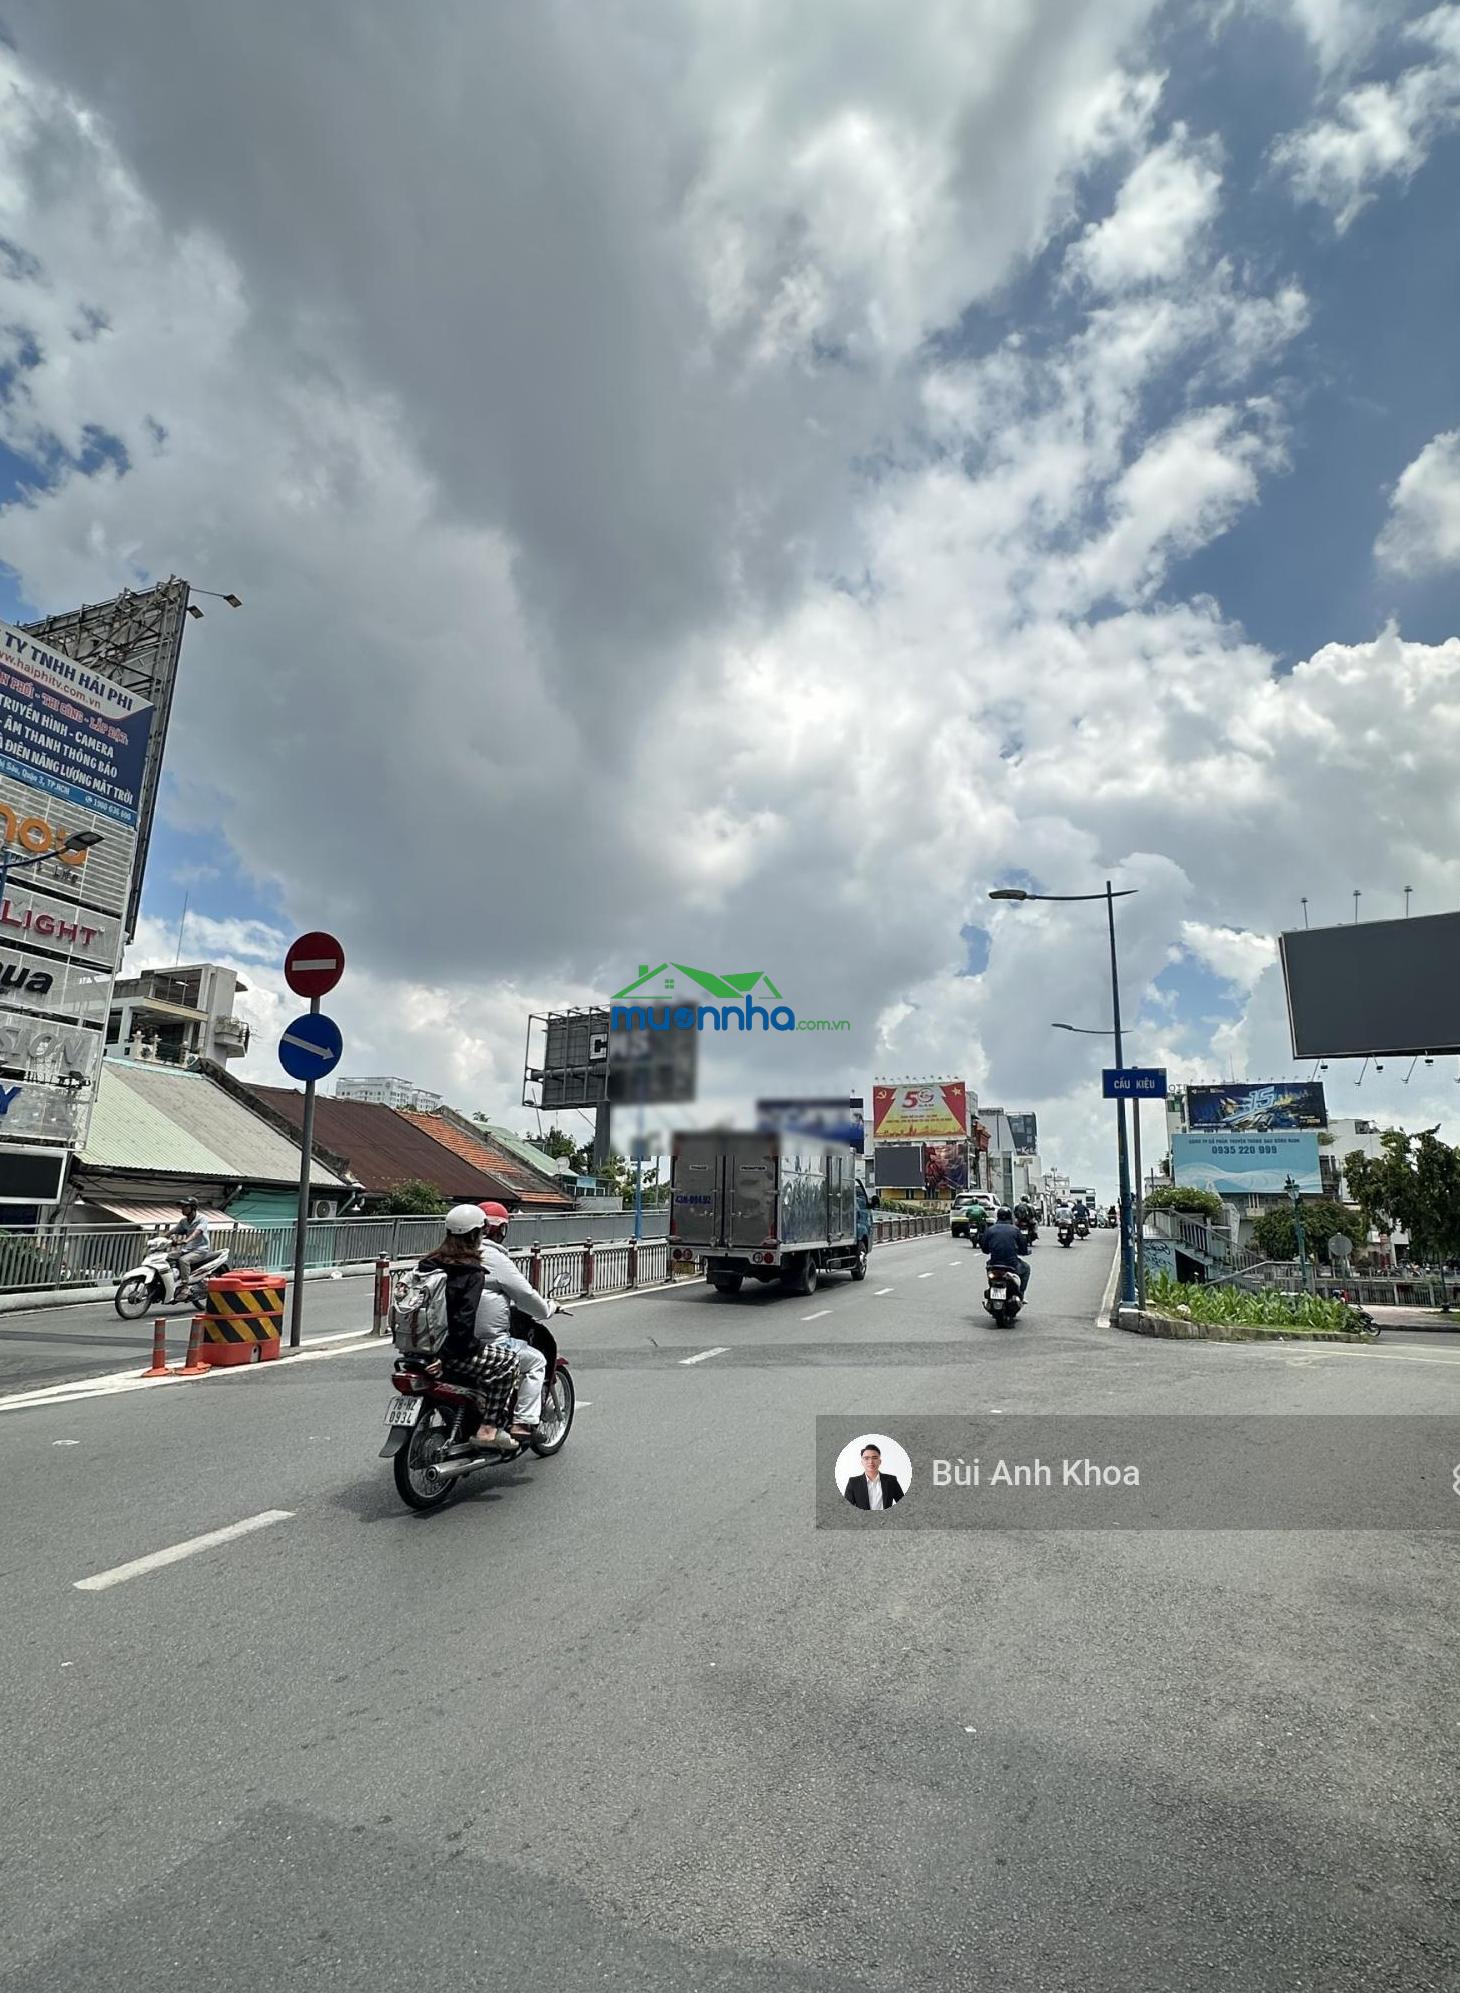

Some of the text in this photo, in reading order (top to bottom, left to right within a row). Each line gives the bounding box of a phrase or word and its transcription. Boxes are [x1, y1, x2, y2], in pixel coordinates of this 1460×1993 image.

[5, 631, 133, 711] TY TNHH HẢI PHI
[4, 714, 22, 736] ÂM
[24, 725, 61, 754] THANH
[62, 743, 97, 769] THÔNG
[97, 760, 118, 778] BÁO
[41, 714, 68, 737] HÌNH
[75, 731, 114, 759] CAMERA
[4, 739, 31, 760] ĐIỆN
[31, 751, 60, 773] NĂNG
[60, 764, 92, 787] LƯỢNG
[92, 777, 113, 797] MẶT
[113, 785, 134, 805] TRỜI
[2, 898, 98, 946] LIGHT
[0, 962, 54, 995] ua
[1135, 1076, 1156, 1091] KIỆU
[1211, 1145, 1236, 1155] 0935
[1238, 1145, 1256, 1155] 220
